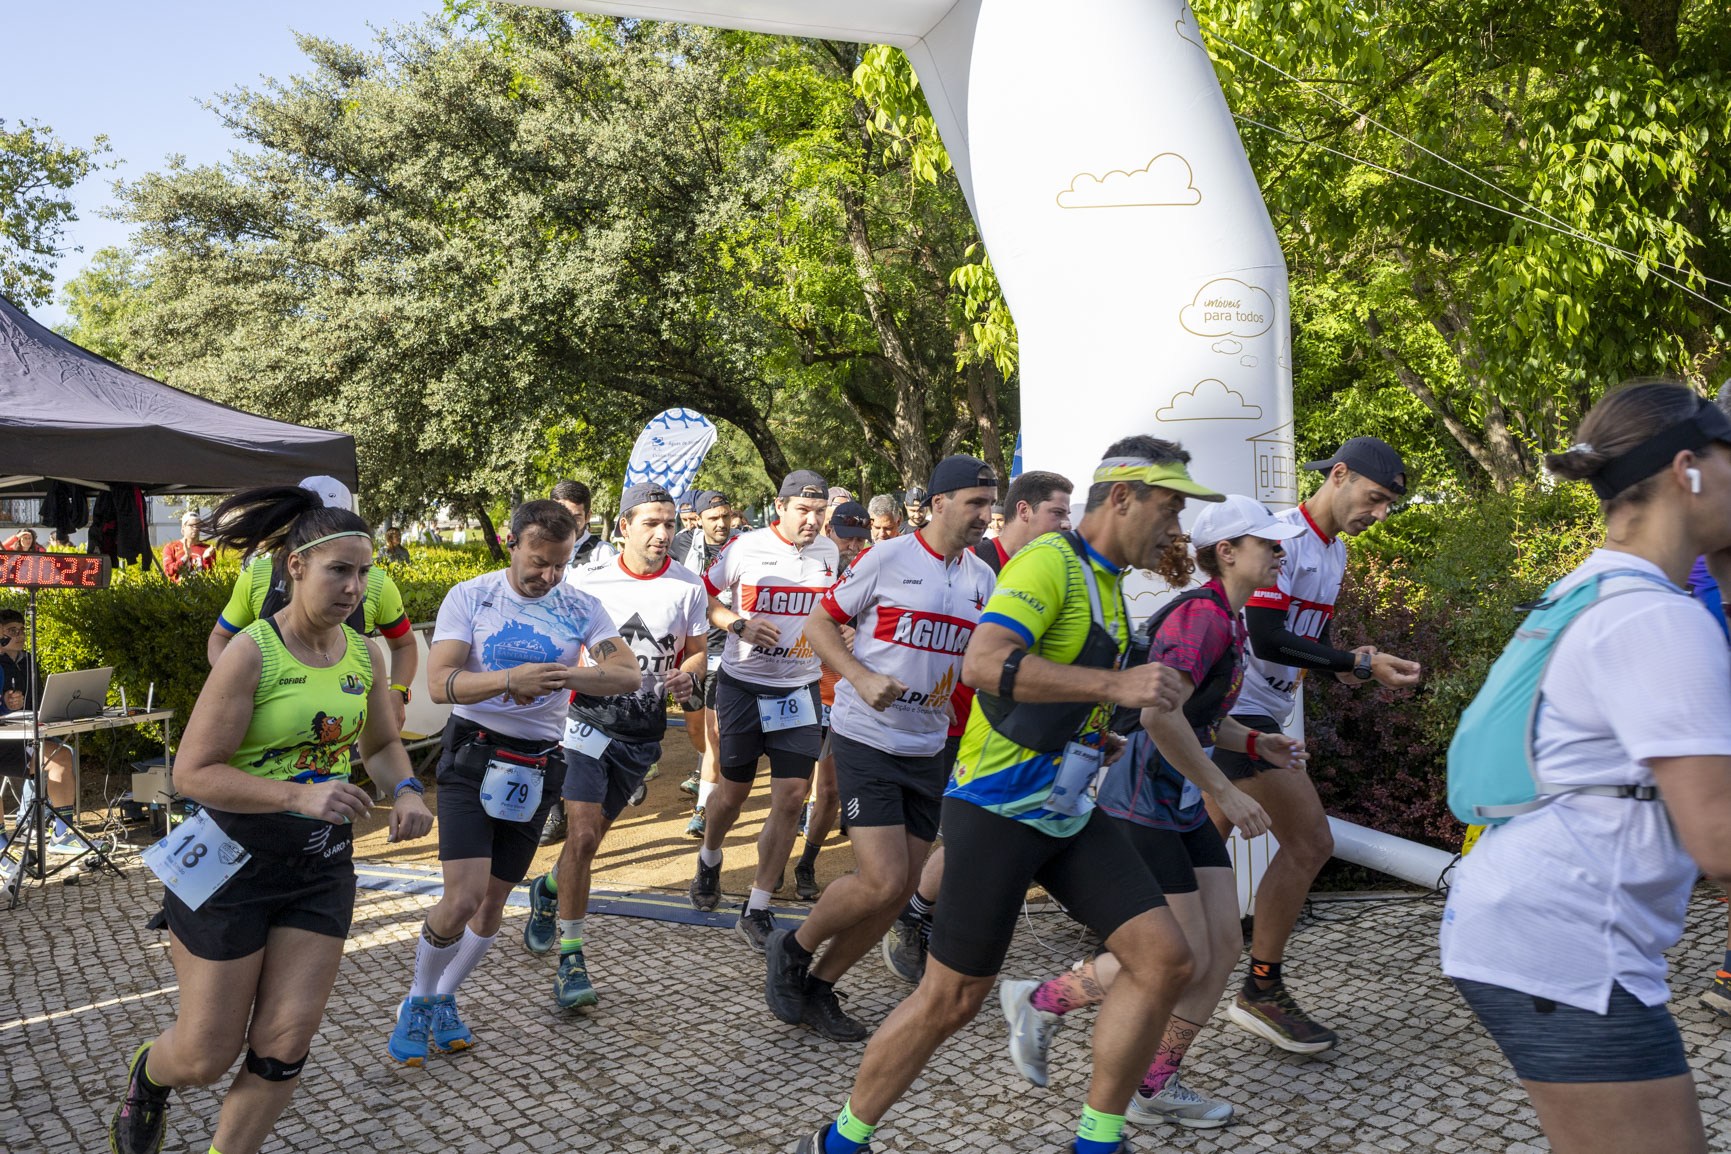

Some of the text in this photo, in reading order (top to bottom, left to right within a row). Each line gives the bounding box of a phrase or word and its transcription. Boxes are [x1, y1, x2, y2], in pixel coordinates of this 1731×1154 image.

[1204, 297, 1240, 308] imóveis
[1204, 311, 1264, 323] para todos
[892, 612, 972, 654] ÁGUIA
[279, 675, 307, 686] COFIDES
[777, 699, 799, 716] 78
[570, 720, 594, 738] 30
[505, 781, 529, 804] 79
[173, 834, 208, 868] 18
